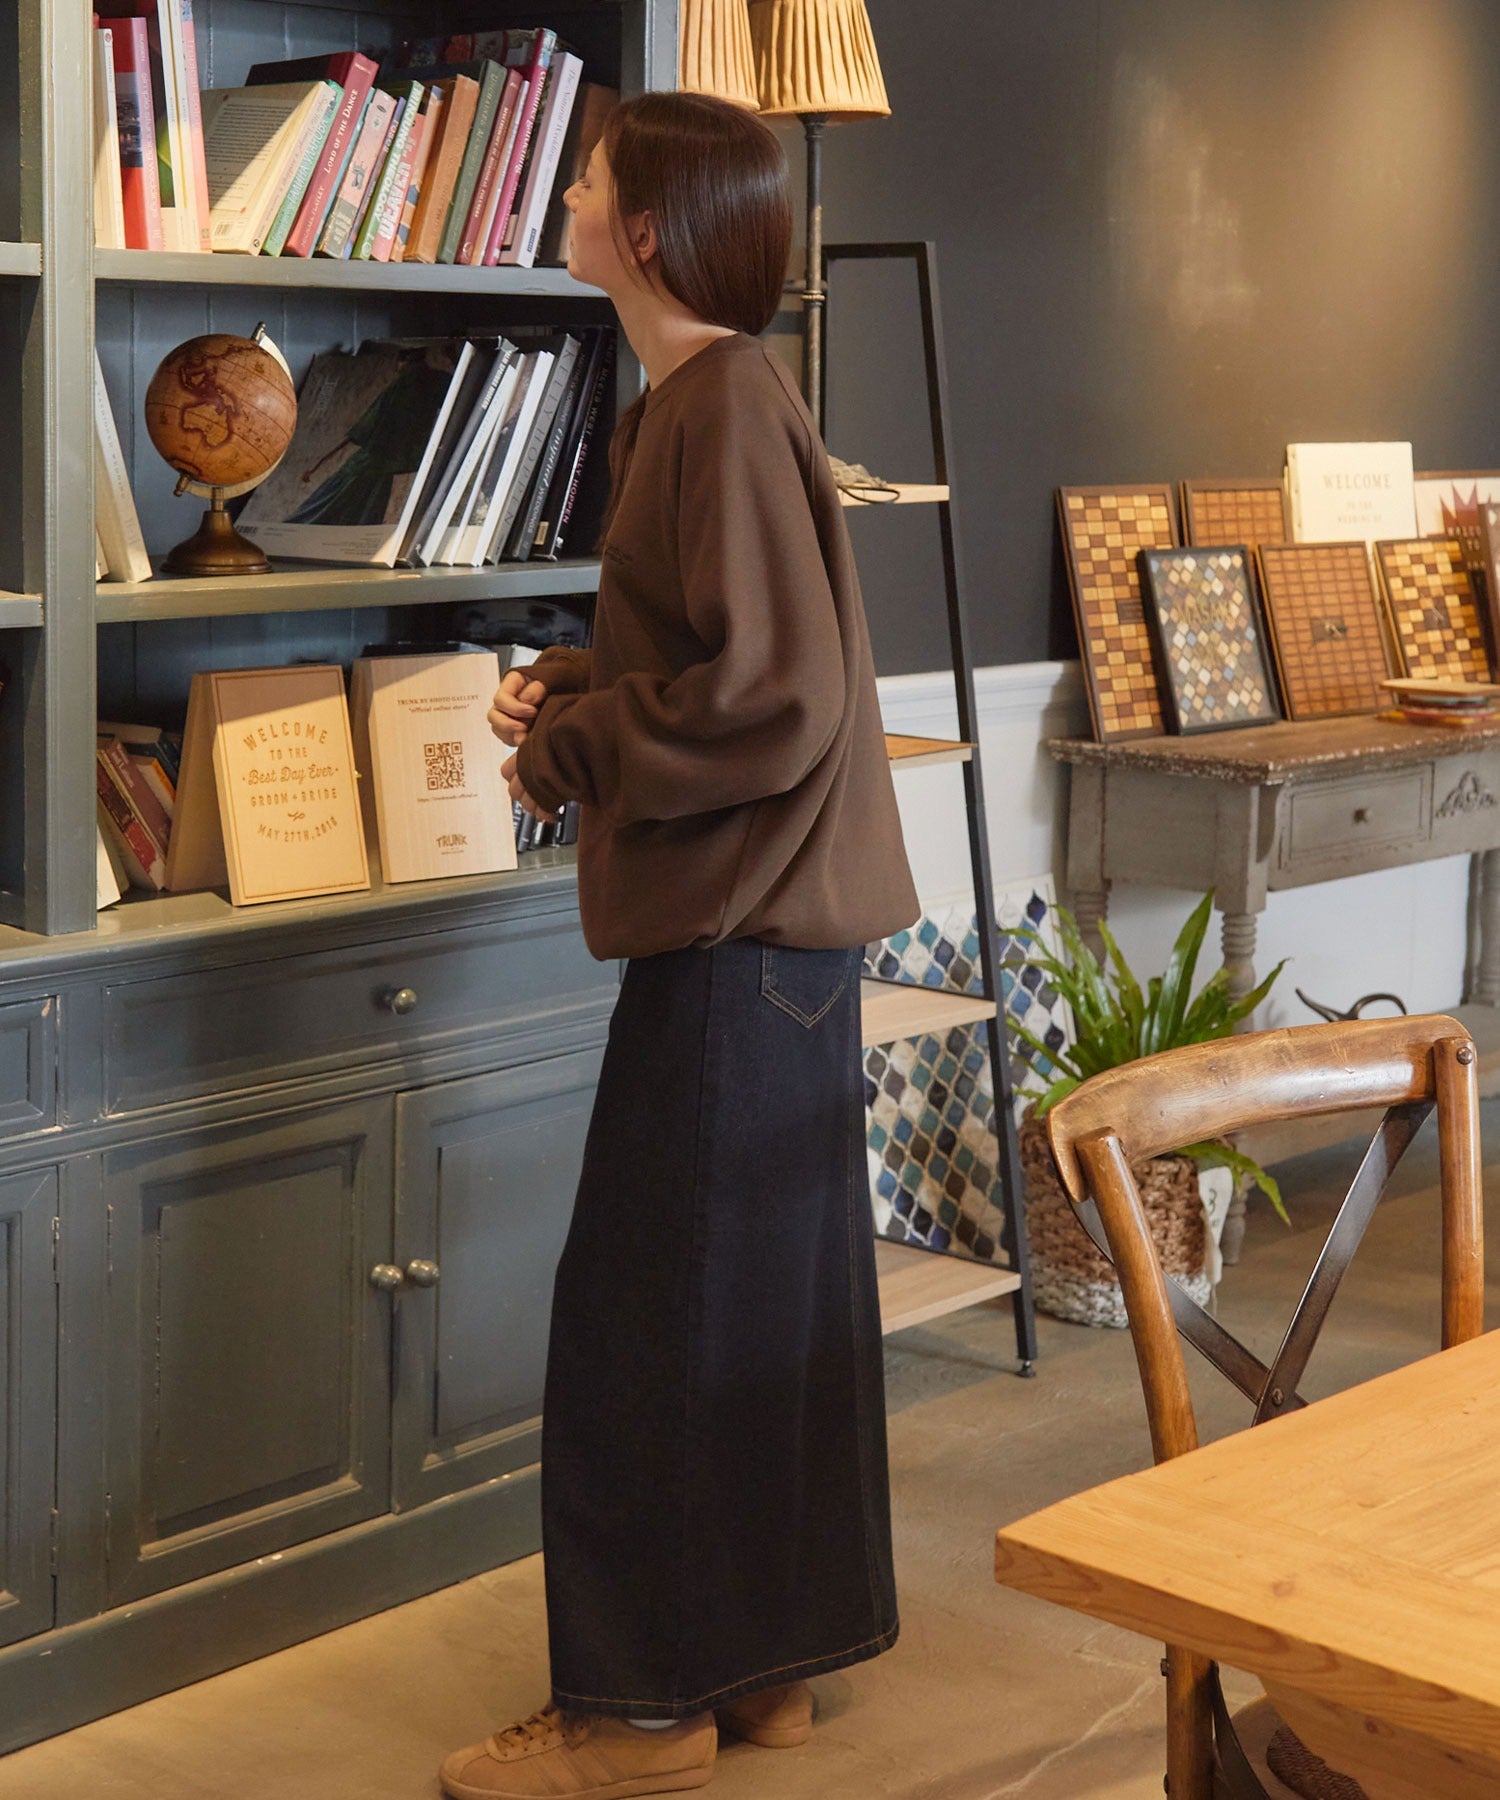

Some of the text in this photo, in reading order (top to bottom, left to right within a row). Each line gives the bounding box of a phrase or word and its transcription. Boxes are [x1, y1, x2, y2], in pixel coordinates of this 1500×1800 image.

[322, 87, 359, 174] LORD OF THE DANCE
[394, 87, 424, 151] MINJUNG
[371, 152, 402, 220] THEOLOGY
[585, 406, 599, 436] WEST
[501, 348, 575, 526] KELLY HOPPEN
[561, 442, 589, 524] KELLY HOPPEN
[1323, 472, 1391, 490] WELCOME
[525, 486, 546, 534] WEDDINGS
[243, 721, 328, 751] WELCOME
[270, 747, 308, 760] TO THE
[248, 763, 335, 785] Best Day Ever
[251, 792, 289, 807] GROOM
[301, 788, 337, 802] BRIDE
[258, 823, 280, 840] MAY
[436, 833, 468, 848] TRUNK
